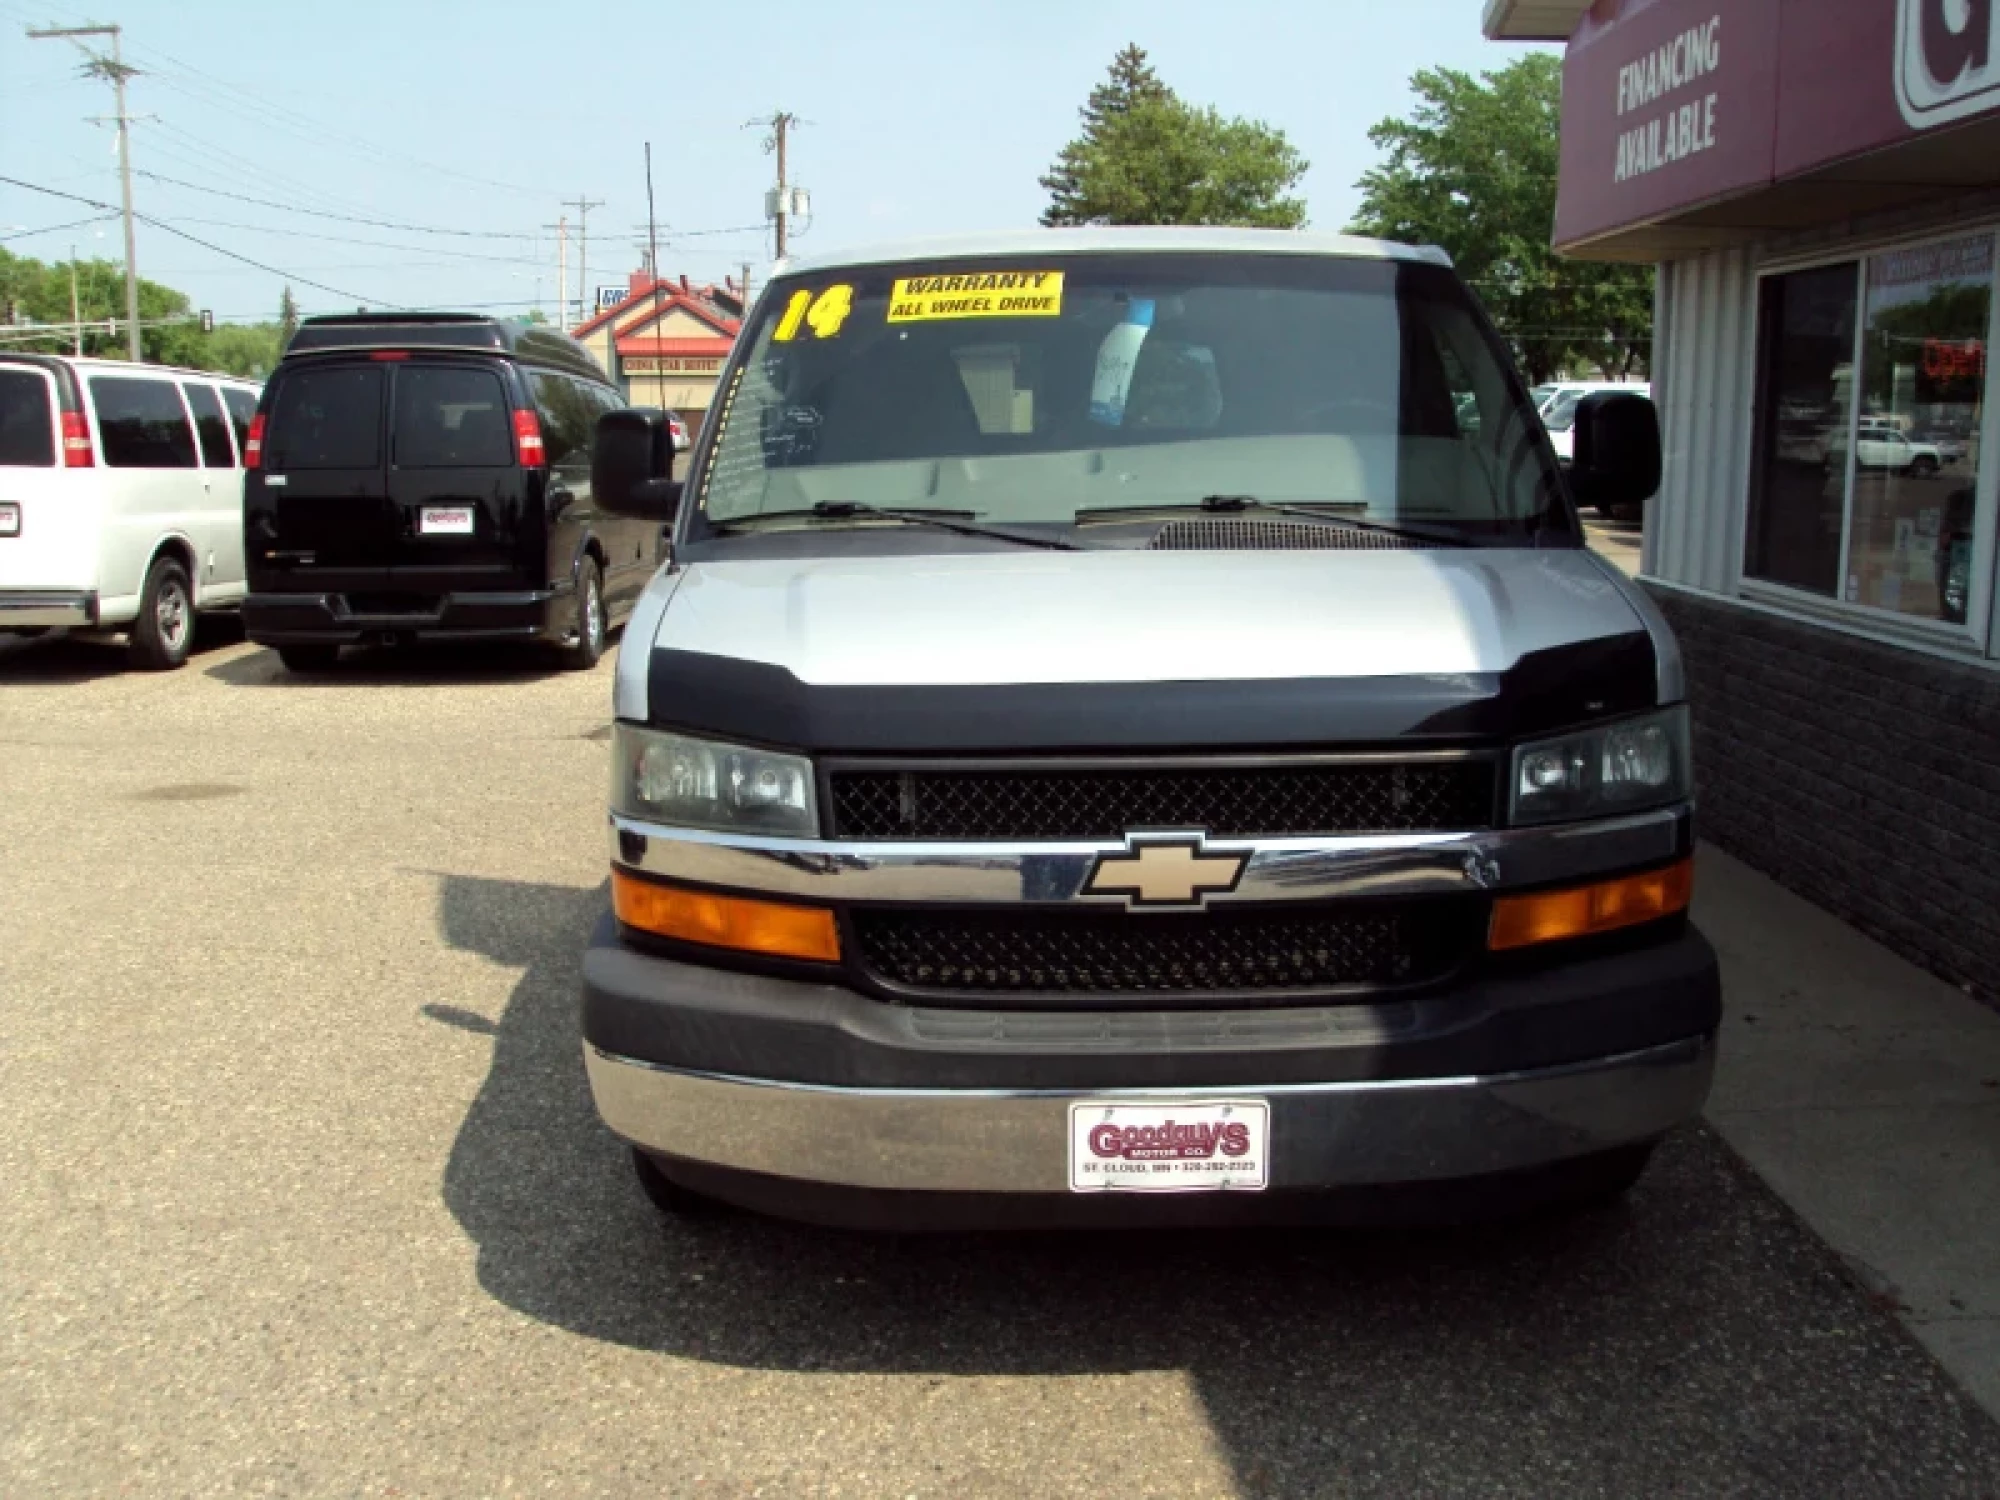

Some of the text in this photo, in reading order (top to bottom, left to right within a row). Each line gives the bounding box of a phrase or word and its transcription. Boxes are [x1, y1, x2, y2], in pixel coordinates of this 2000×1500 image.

[1617, 14, 1721, 116] FINANCING
[1614, 92, 1718, 183] AVAILABLE
[892, 296, 1053, 316] ALL WHEEL DRIVE
[905, 272, 1047, 294] WARRANTY
[772, 284, 853, 341] 14
